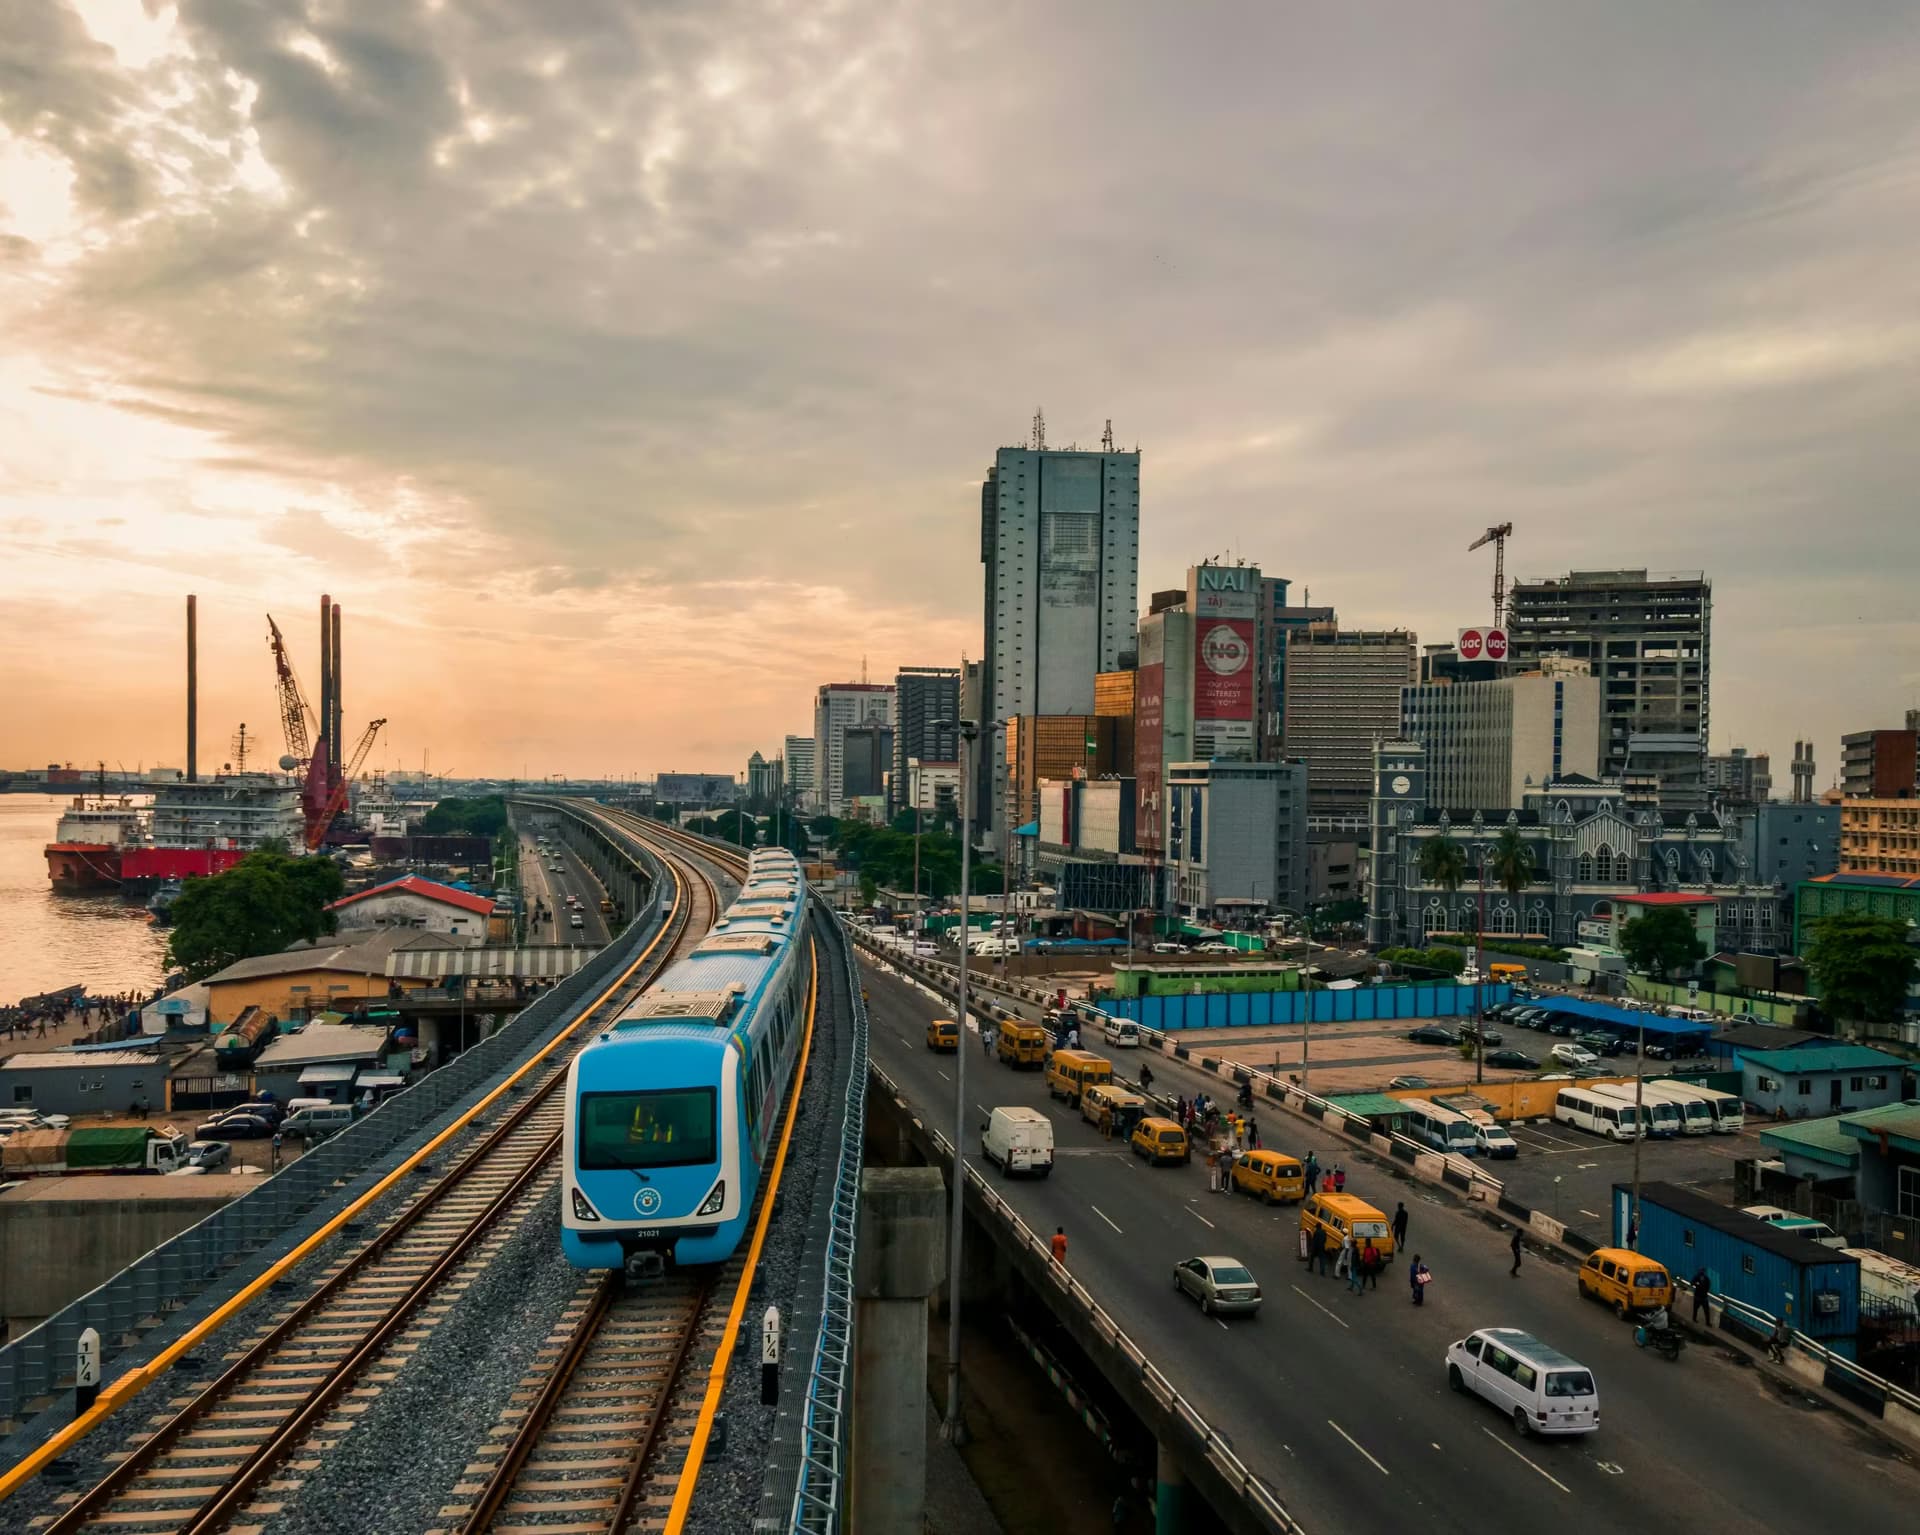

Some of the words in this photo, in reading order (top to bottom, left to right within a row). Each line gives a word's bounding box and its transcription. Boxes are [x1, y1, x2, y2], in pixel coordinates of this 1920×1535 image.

[1461, 639, 1480, 649] uac
[1488, 639, 1505, 649] uac
[638, 1230, 660, 1238] 21021
[767, 1320, 774, 1331] 1
[82, 1342, 89, 1352] 1
